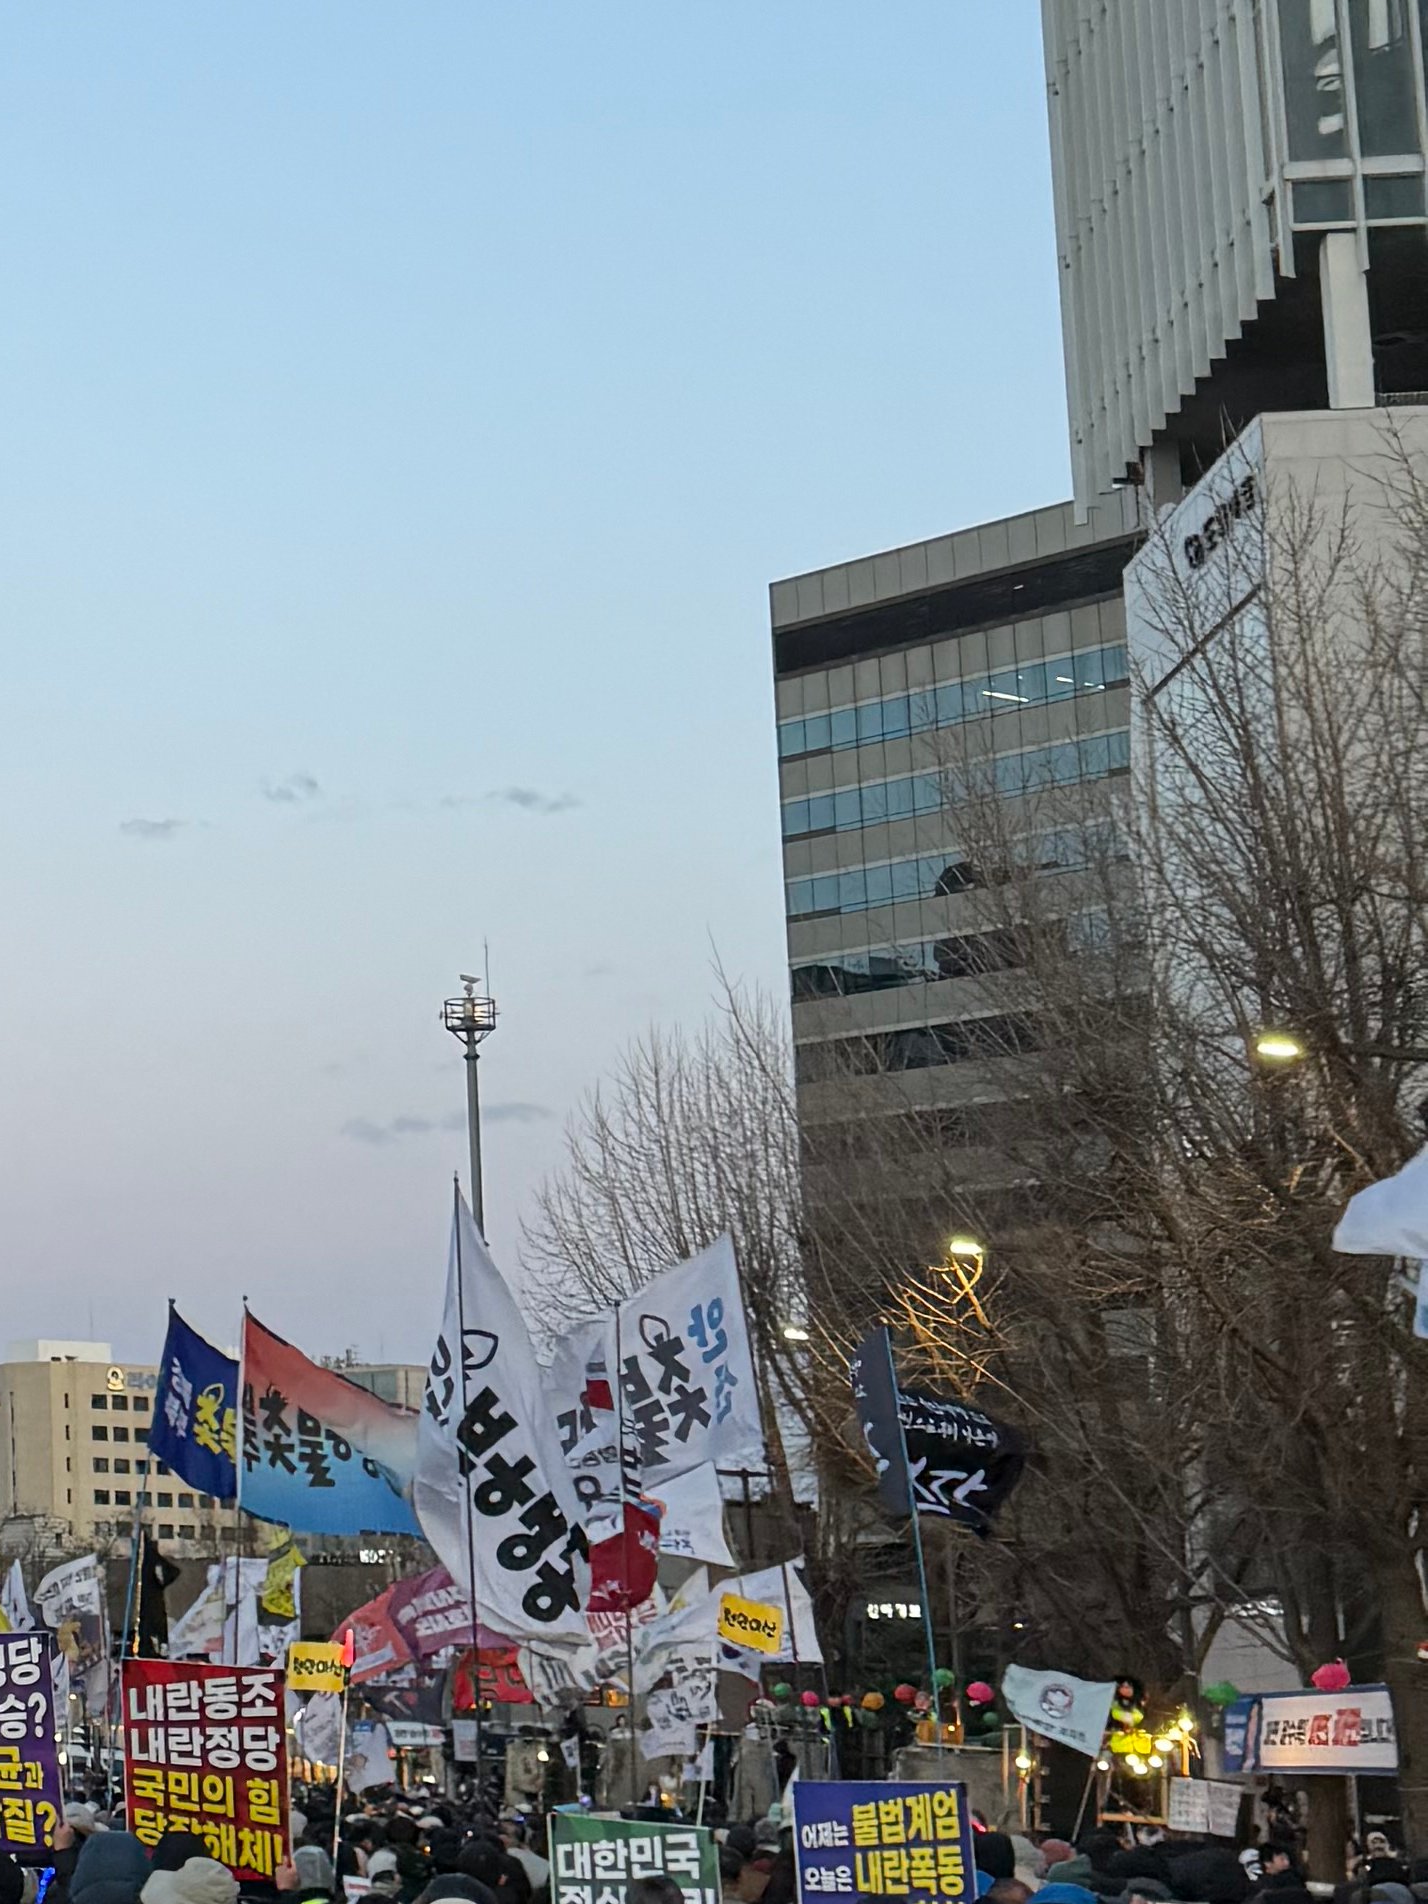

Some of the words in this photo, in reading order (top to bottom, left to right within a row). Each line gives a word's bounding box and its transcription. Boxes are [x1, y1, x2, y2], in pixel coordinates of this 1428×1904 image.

[129, 1673, 278, 1721] 내란동조
[130, 1726, 280, 1772] 내란정당
[132, 1767, 235, 1818] 국민의
[246, 1777, 281, 1826] 힘
[801, 1818, 849, 1850] 어제는
[851, 1788, 962, 1849] 불법계엄
[555, 1831, 703, 1881] 대한민국
[804, 1865, 854, 1893] 오늘은
[854, 1844, 965, 1897] 내란폭동
